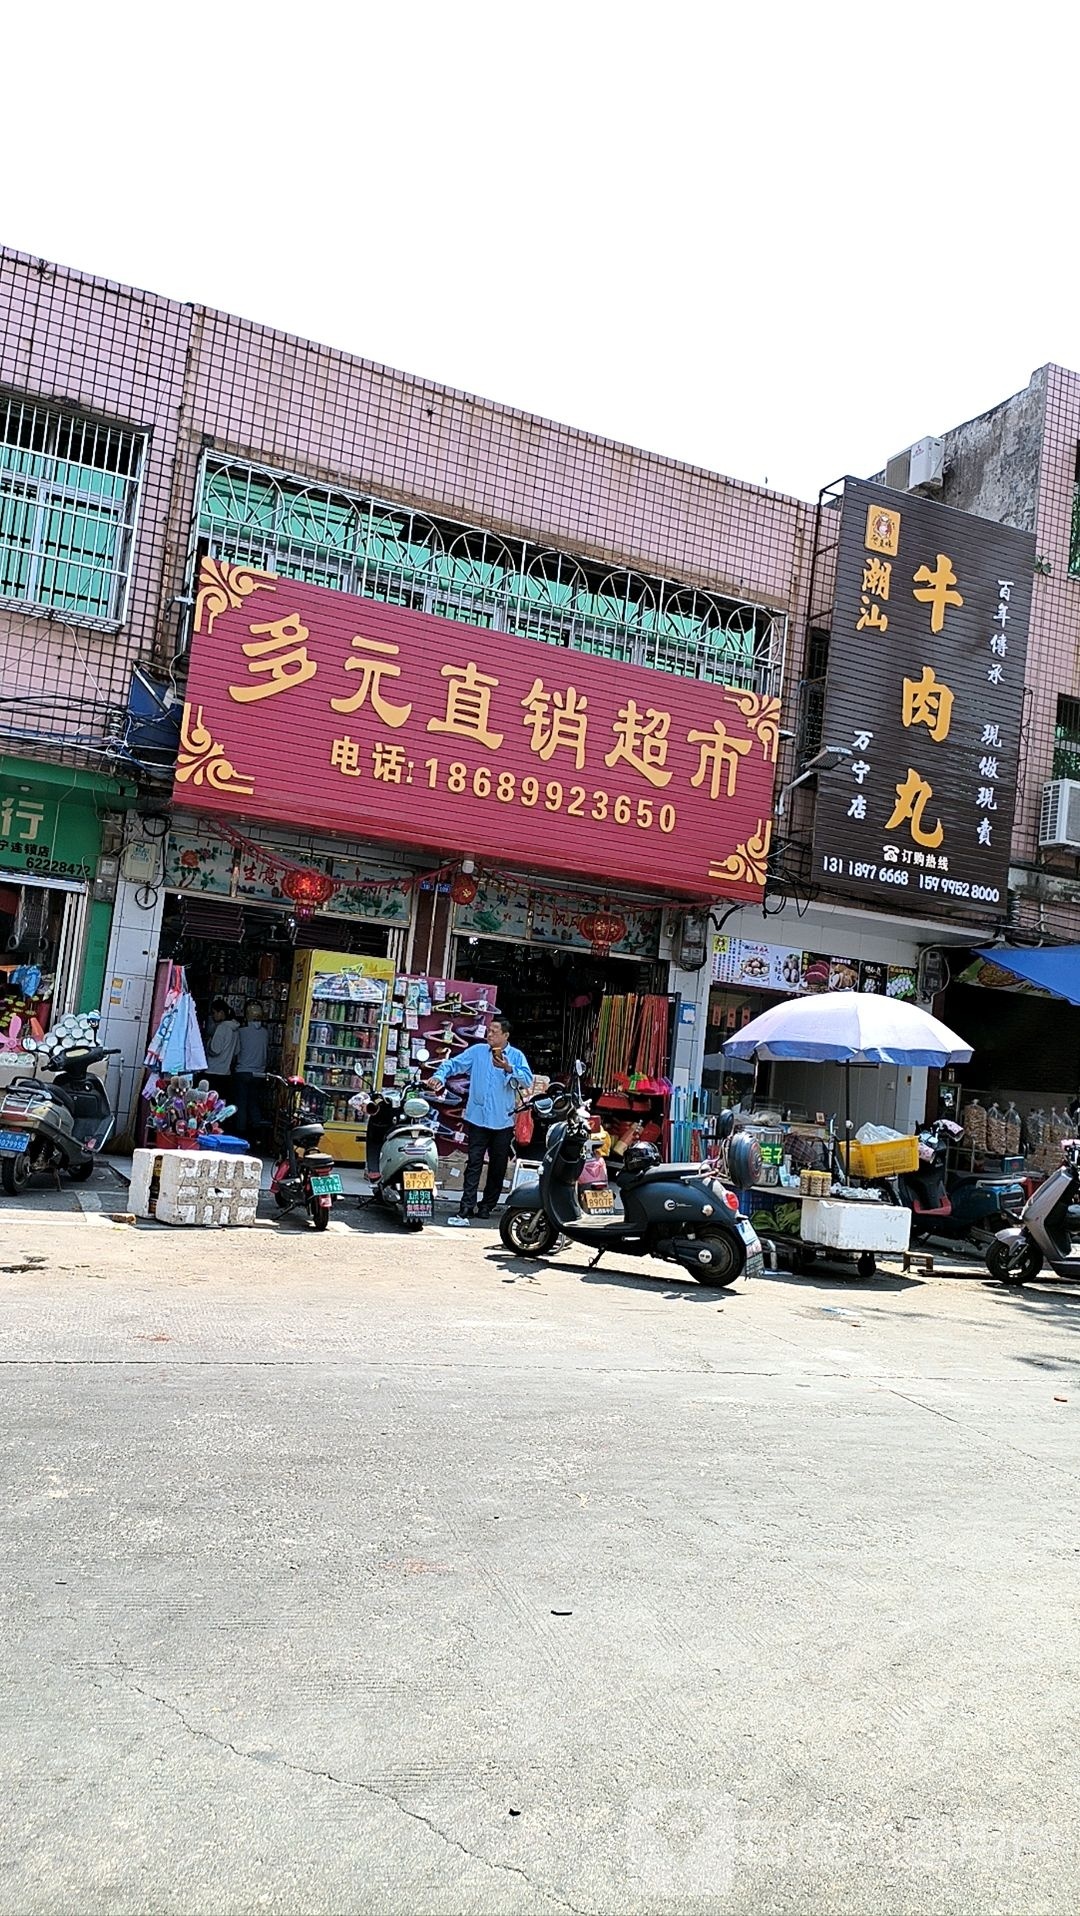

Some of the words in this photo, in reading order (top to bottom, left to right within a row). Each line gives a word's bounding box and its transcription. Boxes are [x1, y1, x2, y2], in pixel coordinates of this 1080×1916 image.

[856, 557, 892, 632] 潮汕
[987, 579, 1015, 685] 百年傳承
[229, 612, 752, 800] 多元直销超市
[884, 554, 963, 849] 牛肉丸
[331, 736, 676, 833] 电话:18689923650
[847, 729, 874, 821] 万宁店
[1, 797, 44, 840] 行
[26, 857, 91, 876] 62228472
[822, 855, 843, 873] 131
[878, 867, 909, 886] 6668
[901, 849, 949, 871] 订购热线
[918, 873, 939, 892] 159
[971, 885, 1000, 903] 8000
